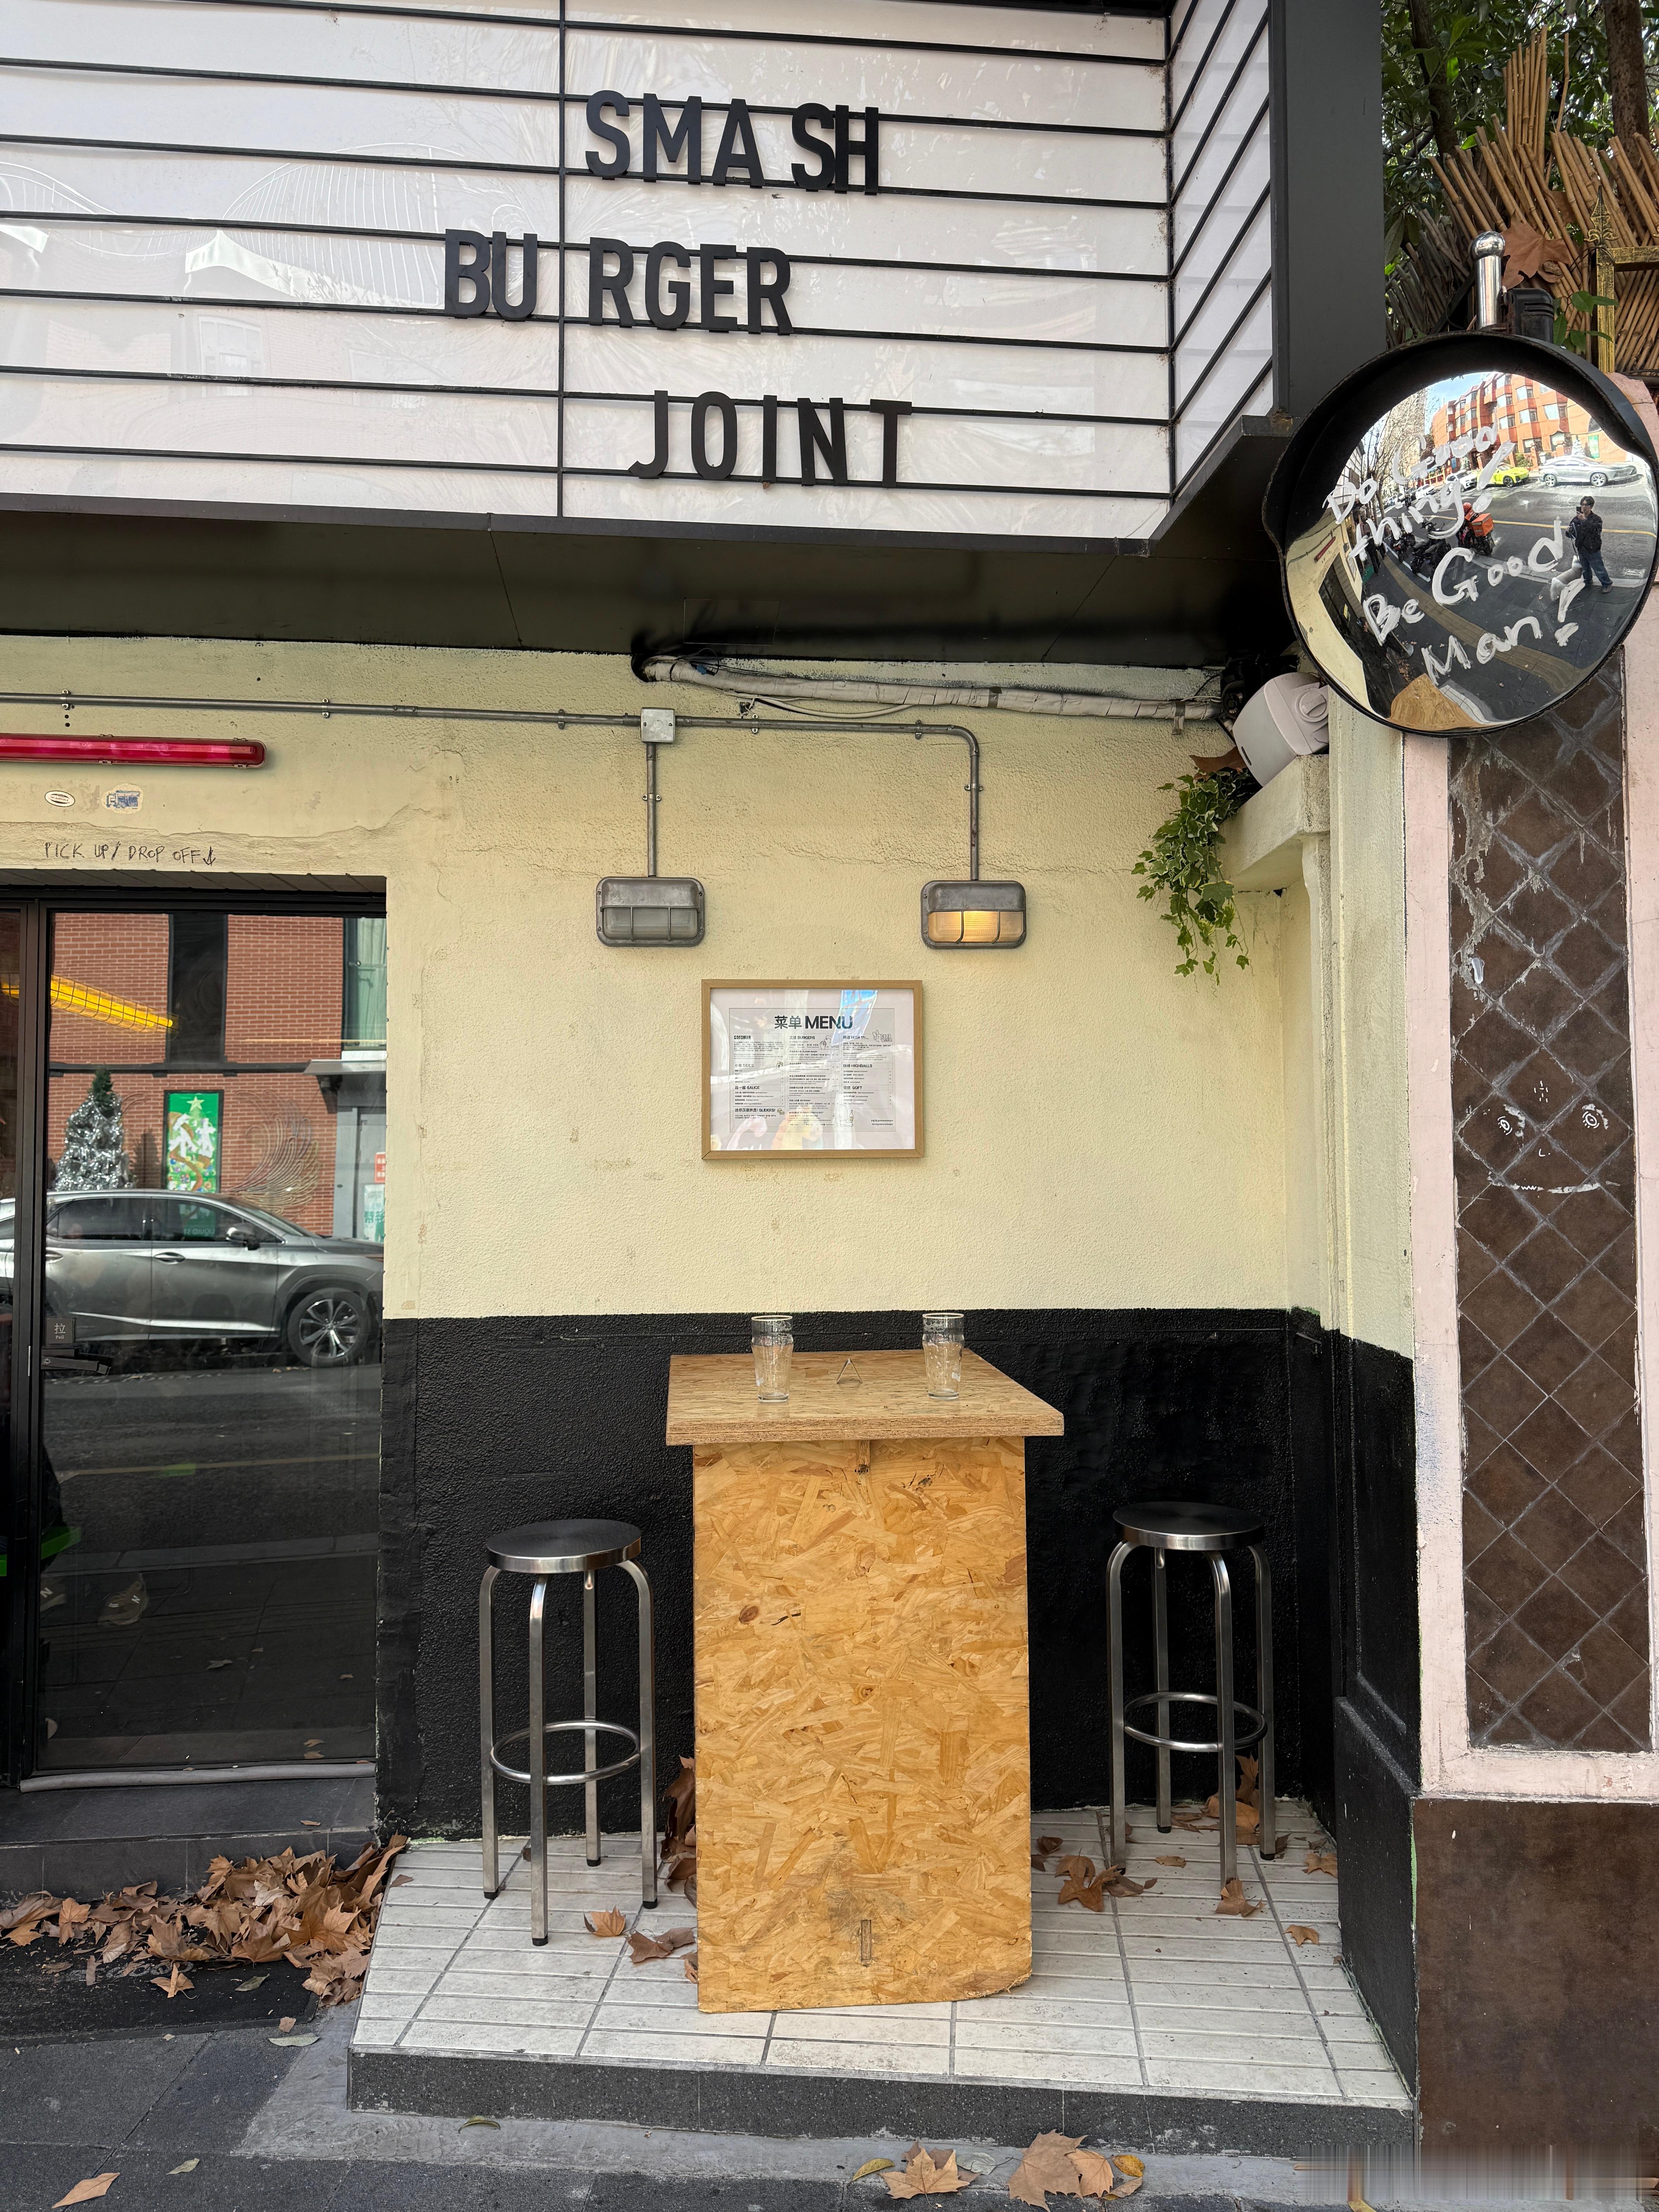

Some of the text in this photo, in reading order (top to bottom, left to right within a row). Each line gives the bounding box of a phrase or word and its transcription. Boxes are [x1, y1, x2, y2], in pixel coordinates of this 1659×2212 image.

[585, 90, 878, 194] SMASH
[445, 228, 794, 335] BURGER
[629, 390, 912, 488] JOINT
[1322, 477, 1379, 525] Do
[1363, 515, 1563, 646] Be Good
[1421, 579, 1586, 686] Man!
[45, 842, 84, 859] PICK
[129, 846, 165, 861] DROP
[172, 848, 201, 864] OFF
[775, 1015, 853, 1029] 菜单 MENU
[54, 1323, 65, 1334] 拉
